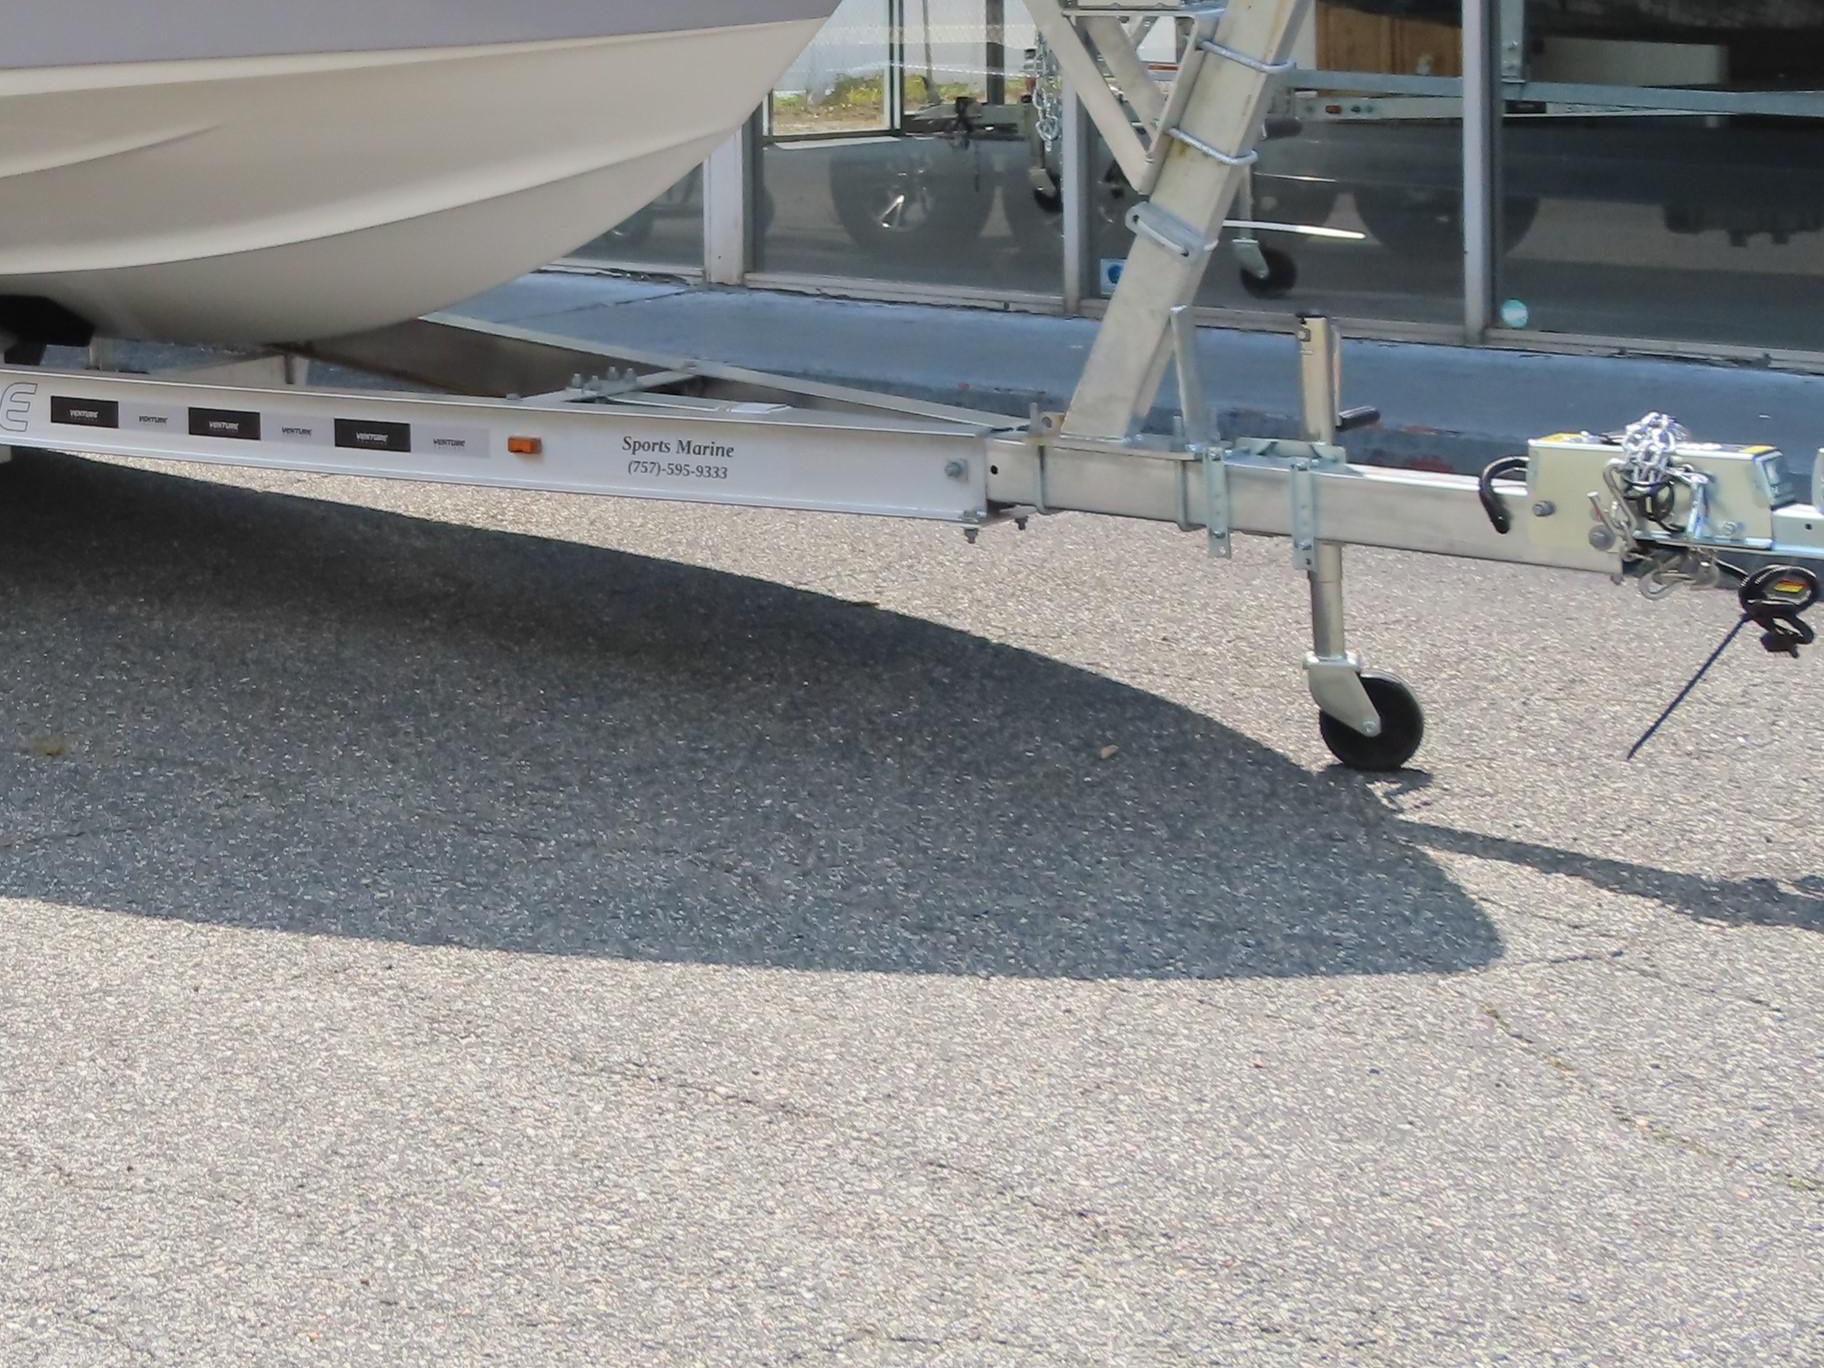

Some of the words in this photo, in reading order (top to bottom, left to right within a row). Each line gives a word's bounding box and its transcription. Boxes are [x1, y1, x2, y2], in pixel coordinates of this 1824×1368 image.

[622, 435, 672, 455] Sports
[676, 439, 735, 458] Marine
[627, 460, 729, 480] (757)-595-9333
